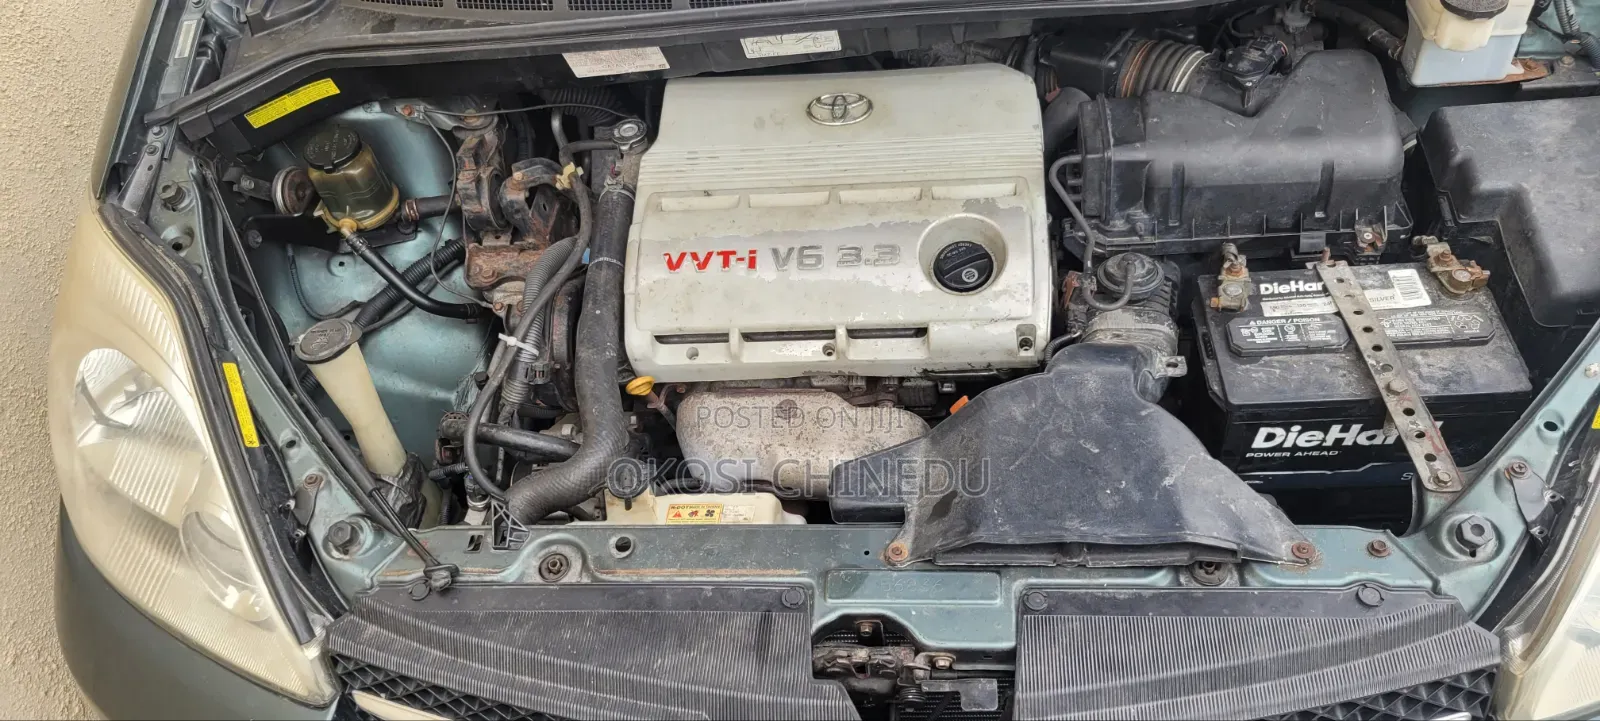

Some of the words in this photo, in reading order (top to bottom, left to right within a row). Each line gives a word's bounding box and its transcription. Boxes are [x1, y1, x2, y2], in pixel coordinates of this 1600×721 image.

[663, 248, 758, 273] VVT-i
[770, 244, 825, 272] V6
[837, 243, 901, 268] 3.3
[1260, 280, 1325, 295] DieHar
[1368, 295, 1396, 303] SILVER
[1256, 318, 1286, 326] DANGER
[1251, 421, 1444, 449] DieHar
